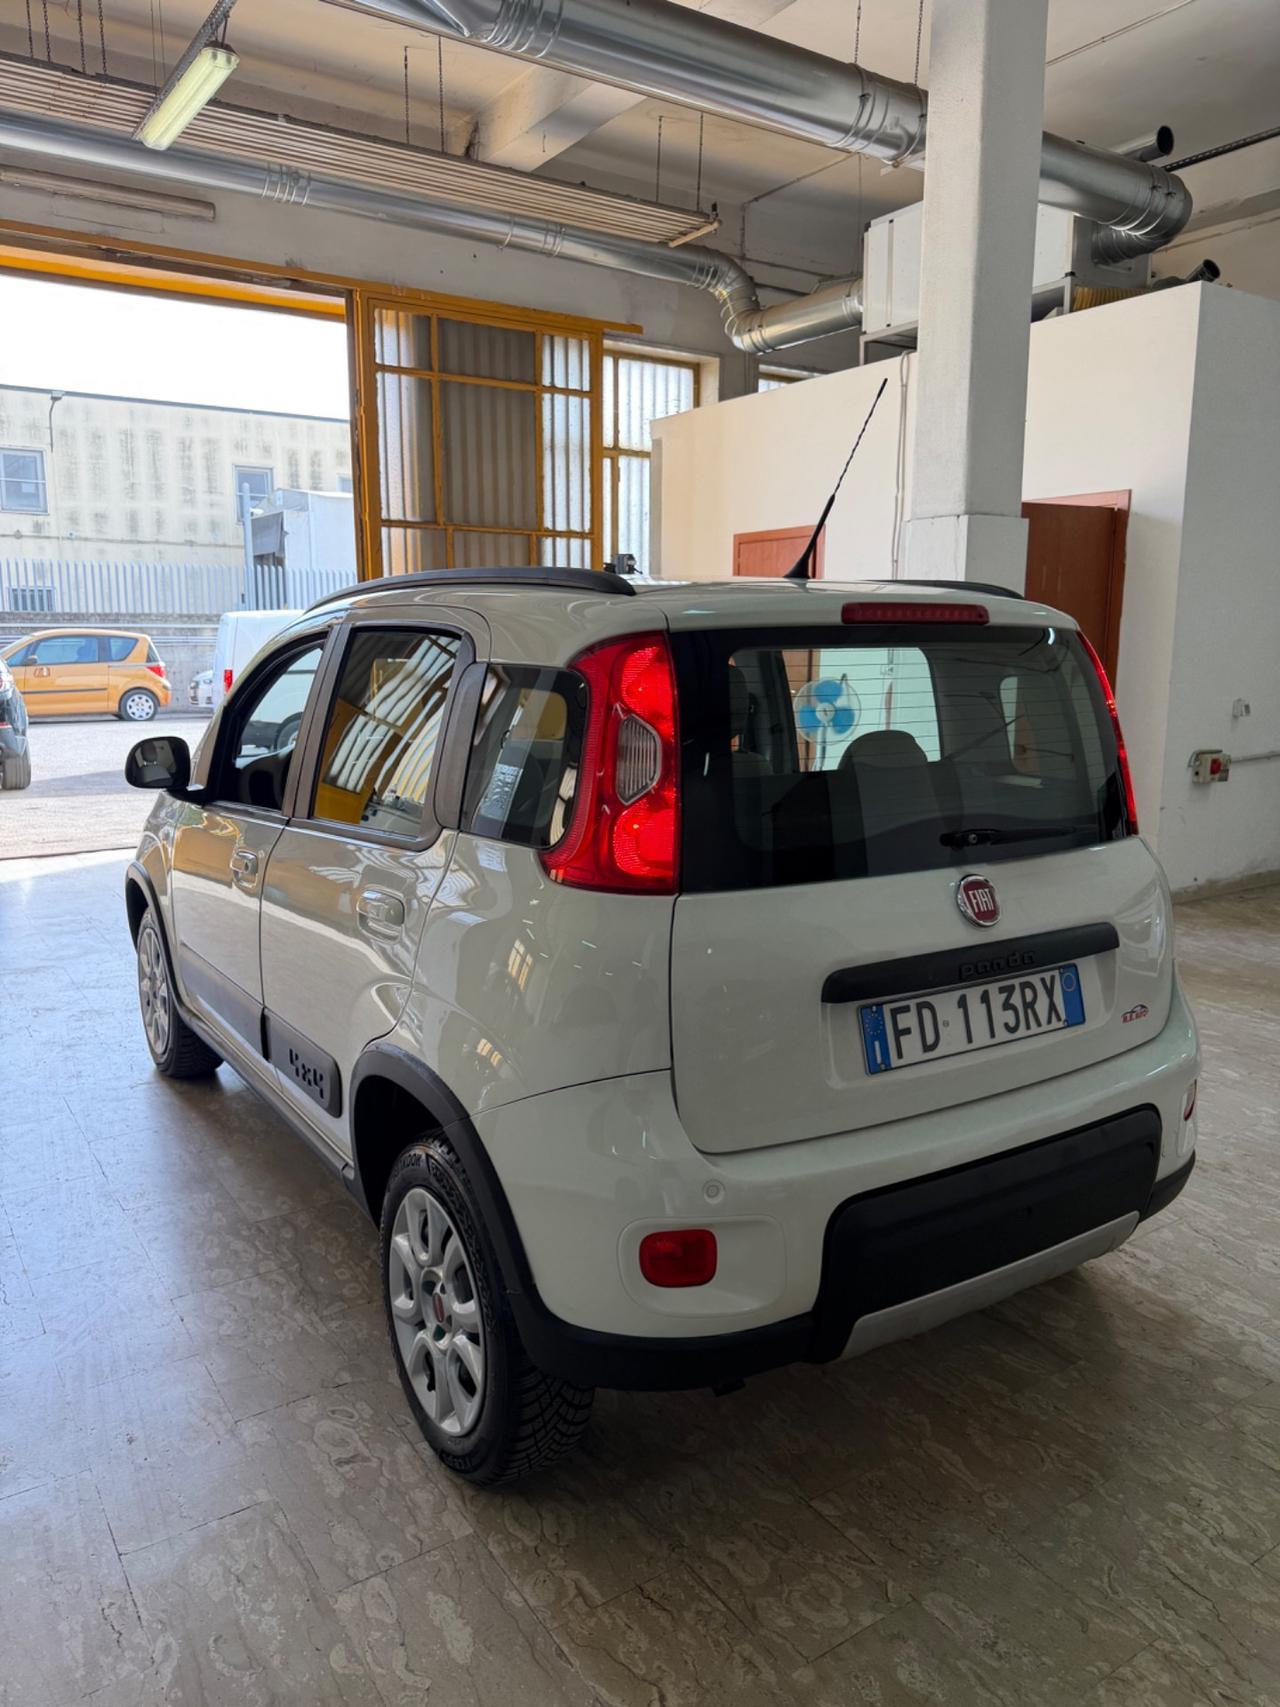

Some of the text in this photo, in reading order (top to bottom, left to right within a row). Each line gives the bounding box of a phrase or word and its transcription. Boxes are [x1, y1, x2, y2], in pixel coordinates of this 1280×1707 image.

[968, 888, 994, 912] FIAT
[889, 974, 1063, 1060] FD 113RX
